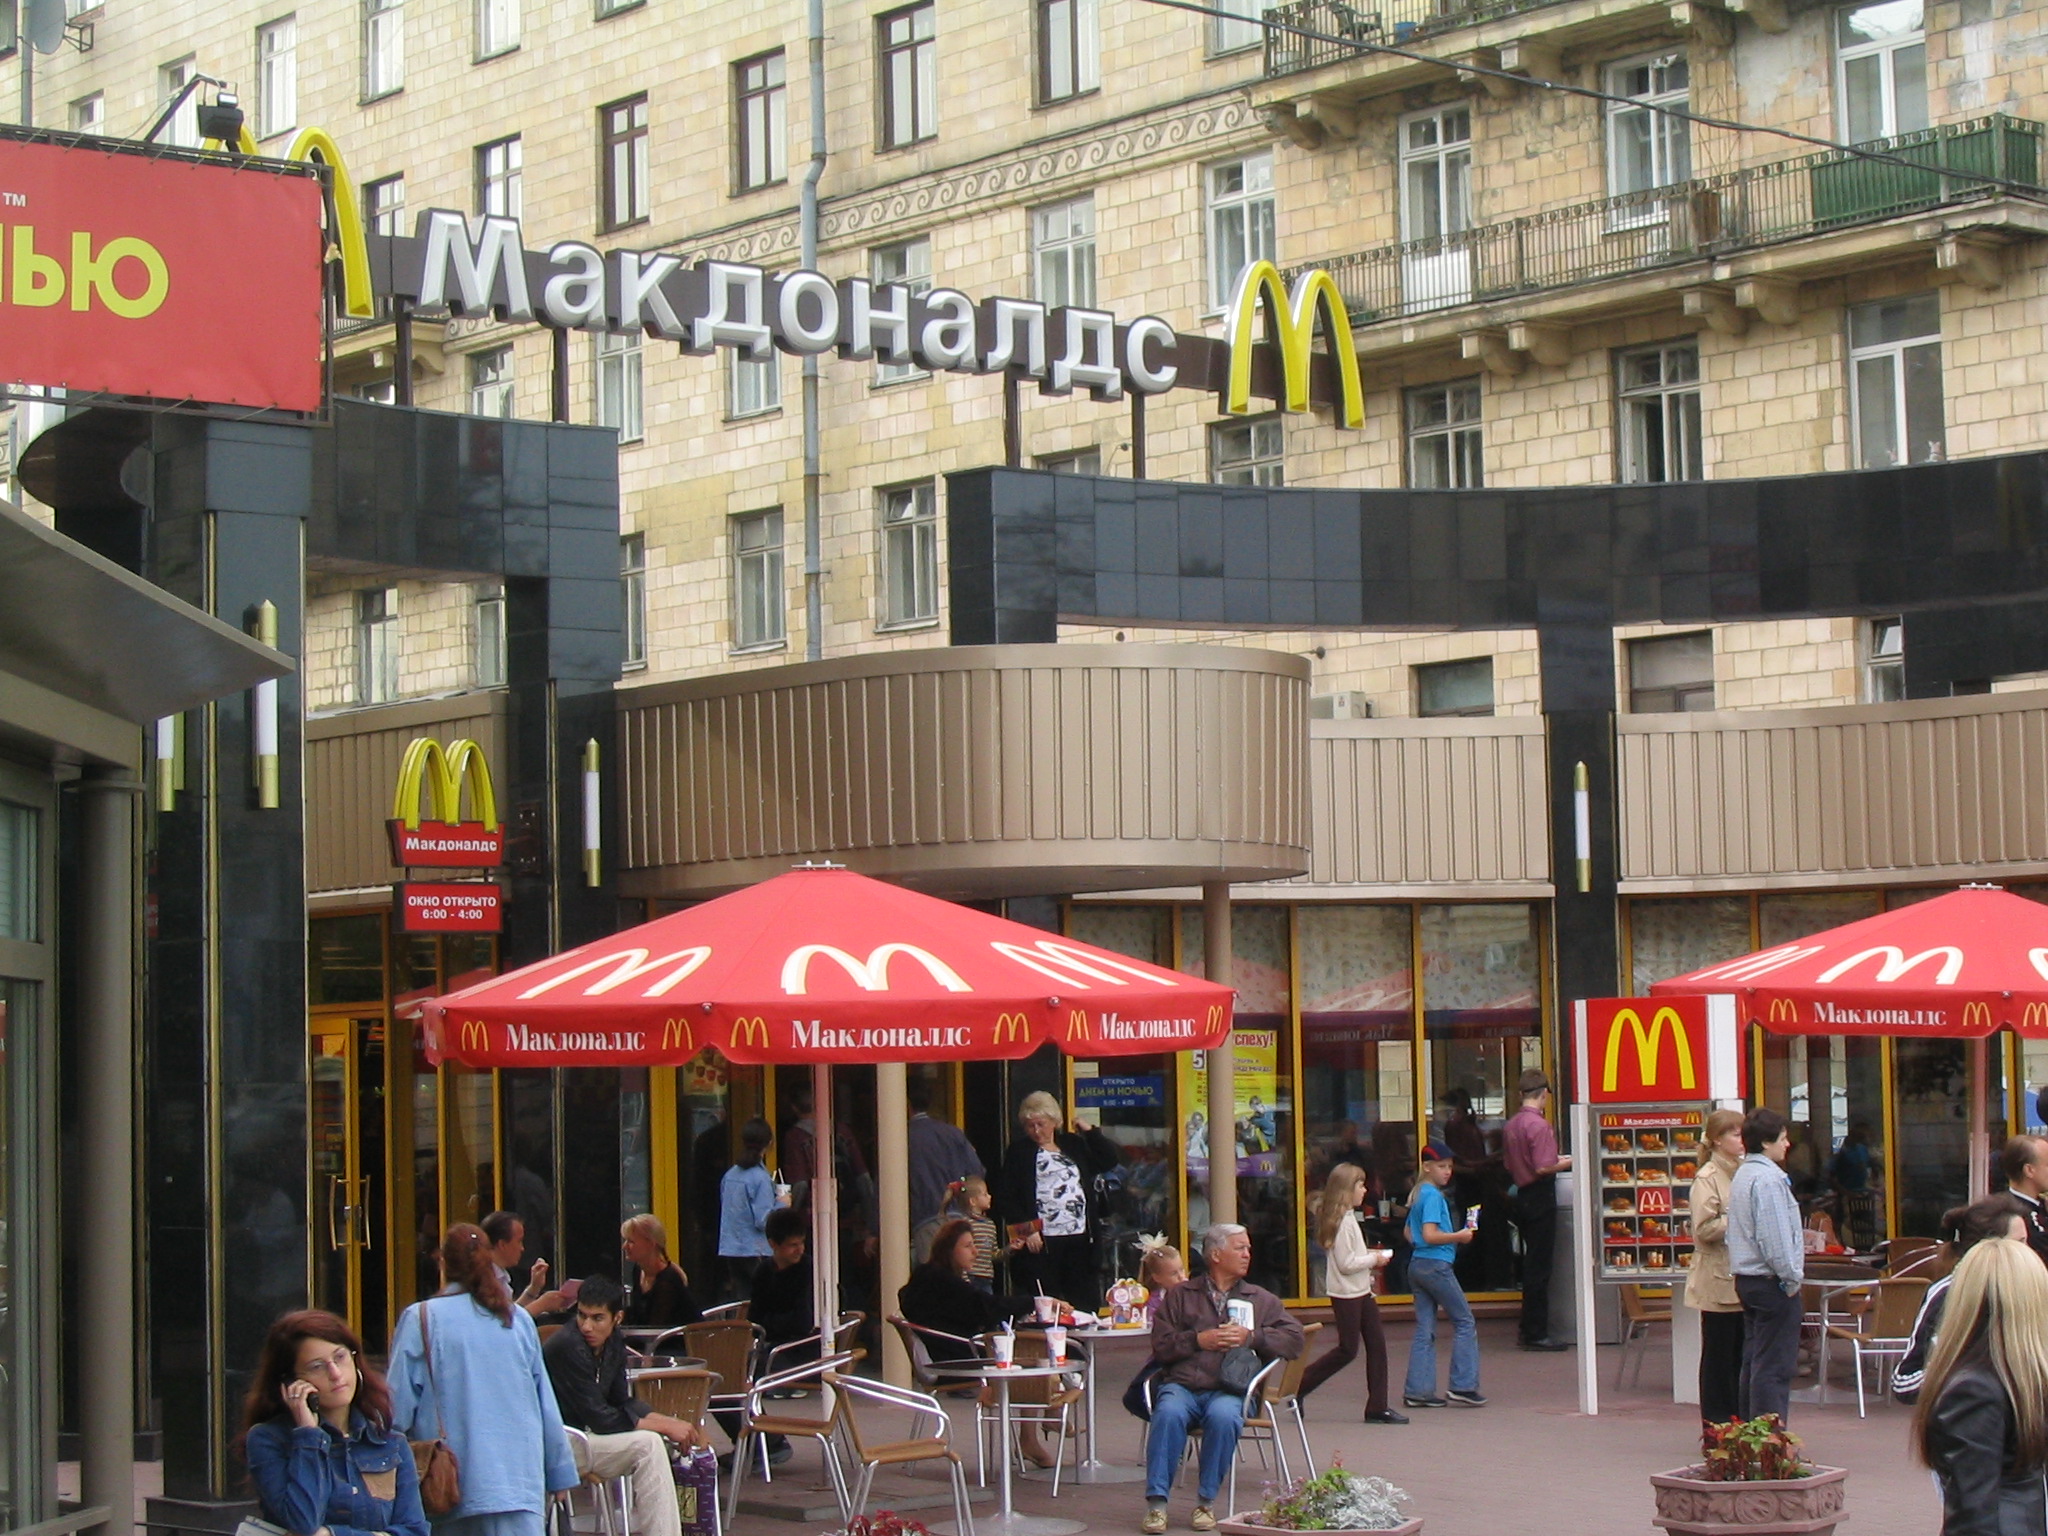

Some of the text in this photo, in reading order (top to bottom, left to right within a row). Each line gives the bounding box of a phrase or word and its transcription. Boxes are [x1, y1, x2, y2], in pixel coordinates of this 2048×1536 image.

[0, 222, 170, 319] ЬЮ
[418, 207, 1179, 400] Макдоналдс
[405, 837, 498, 852] Макдоналдс
[408, 896, 497, 908] ОКНО ОТКРЫТО
[422, 909, 448, 920] 6:00
[458, 909, 483, 920] 4:00
[1099, 1012, 1197, 1041] Макдоналдс
[1813, 1001, 1948, 1027] Макдоналдс
[505, 1023, 646, 1052] Макдоналдс
[791, 1018, 971, 1049] Макдоналдс
[1232, 1031, 1275, 1049] спеху!
[1623, 1117, 1682, 1126] Макдоналдс
